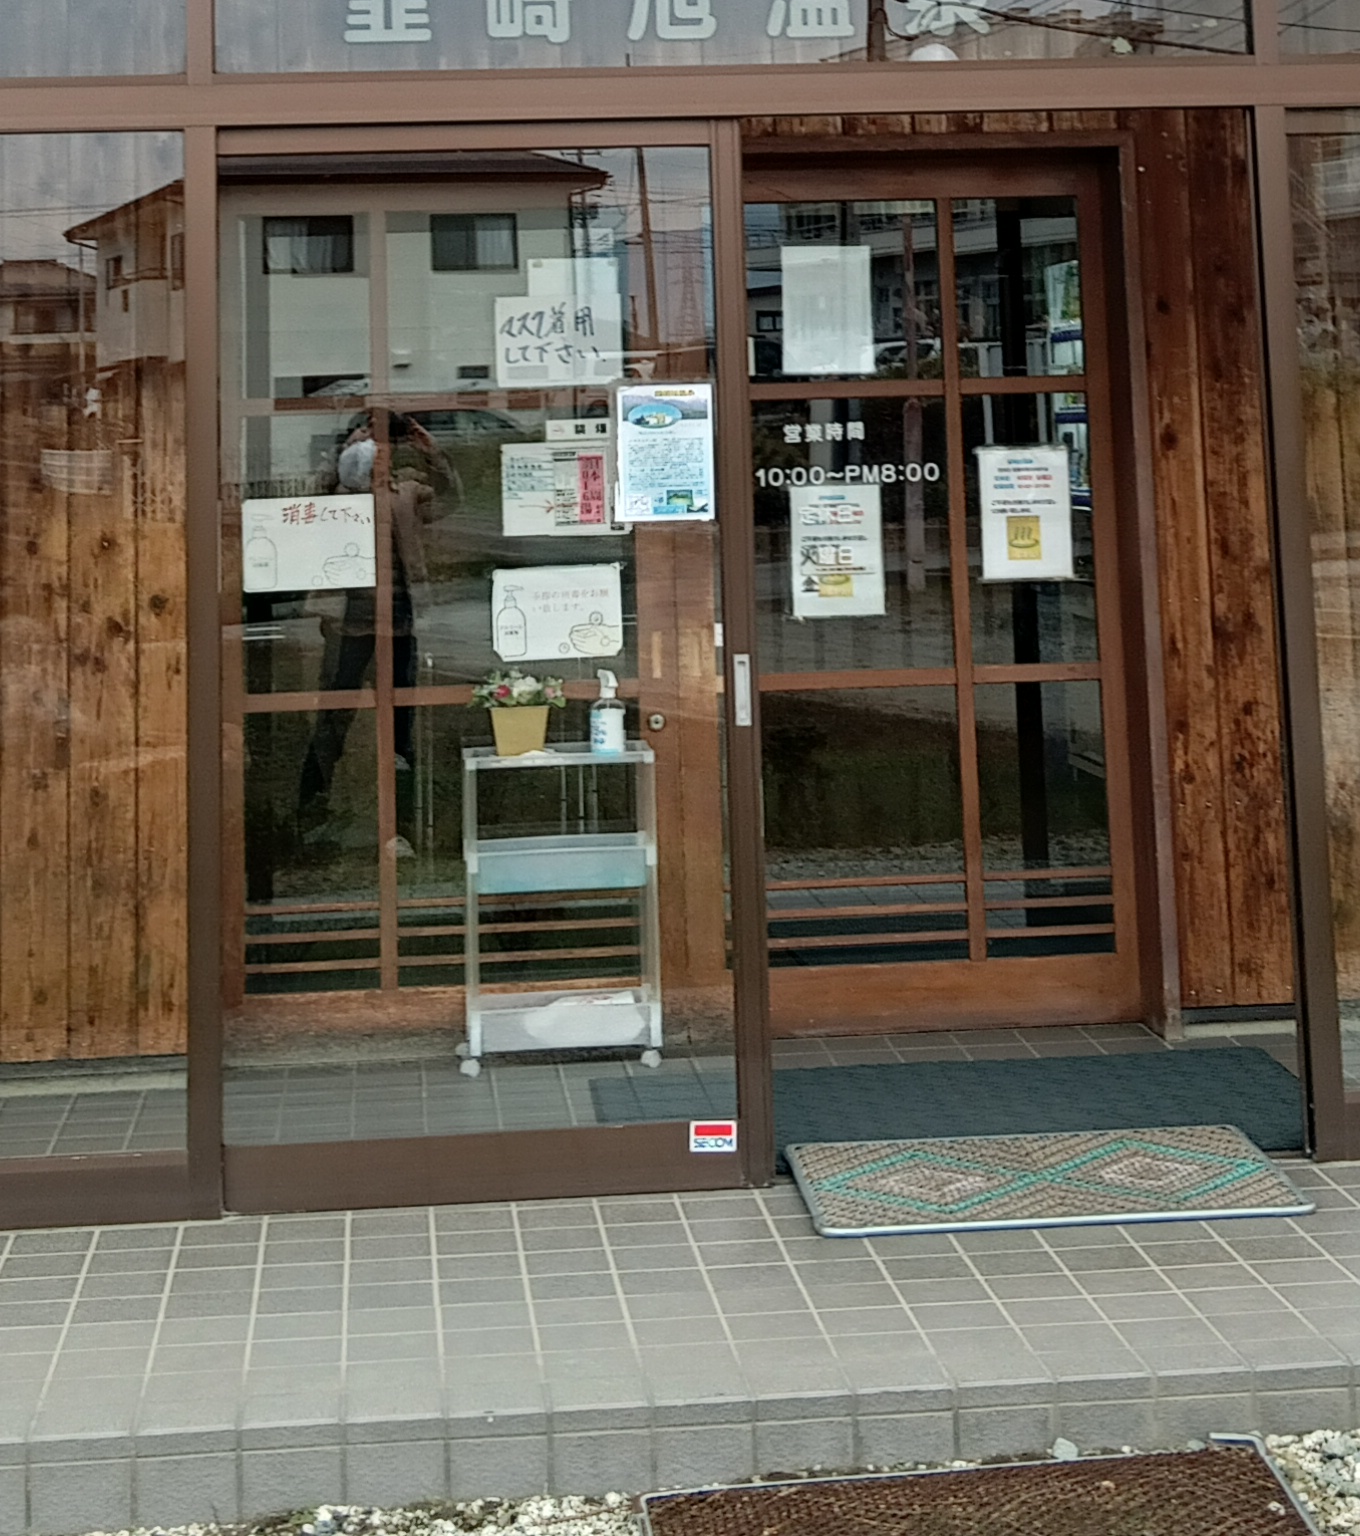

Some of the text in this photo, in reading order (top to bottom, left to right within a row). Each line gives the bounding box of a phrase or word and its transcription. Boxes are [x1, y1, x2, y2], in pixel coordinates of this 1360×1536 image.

[500, 301, 595, 339] マスク着用
[782, 421, 866, 443] 営業時間
[693, 1138, 734, 1148] SECOM
